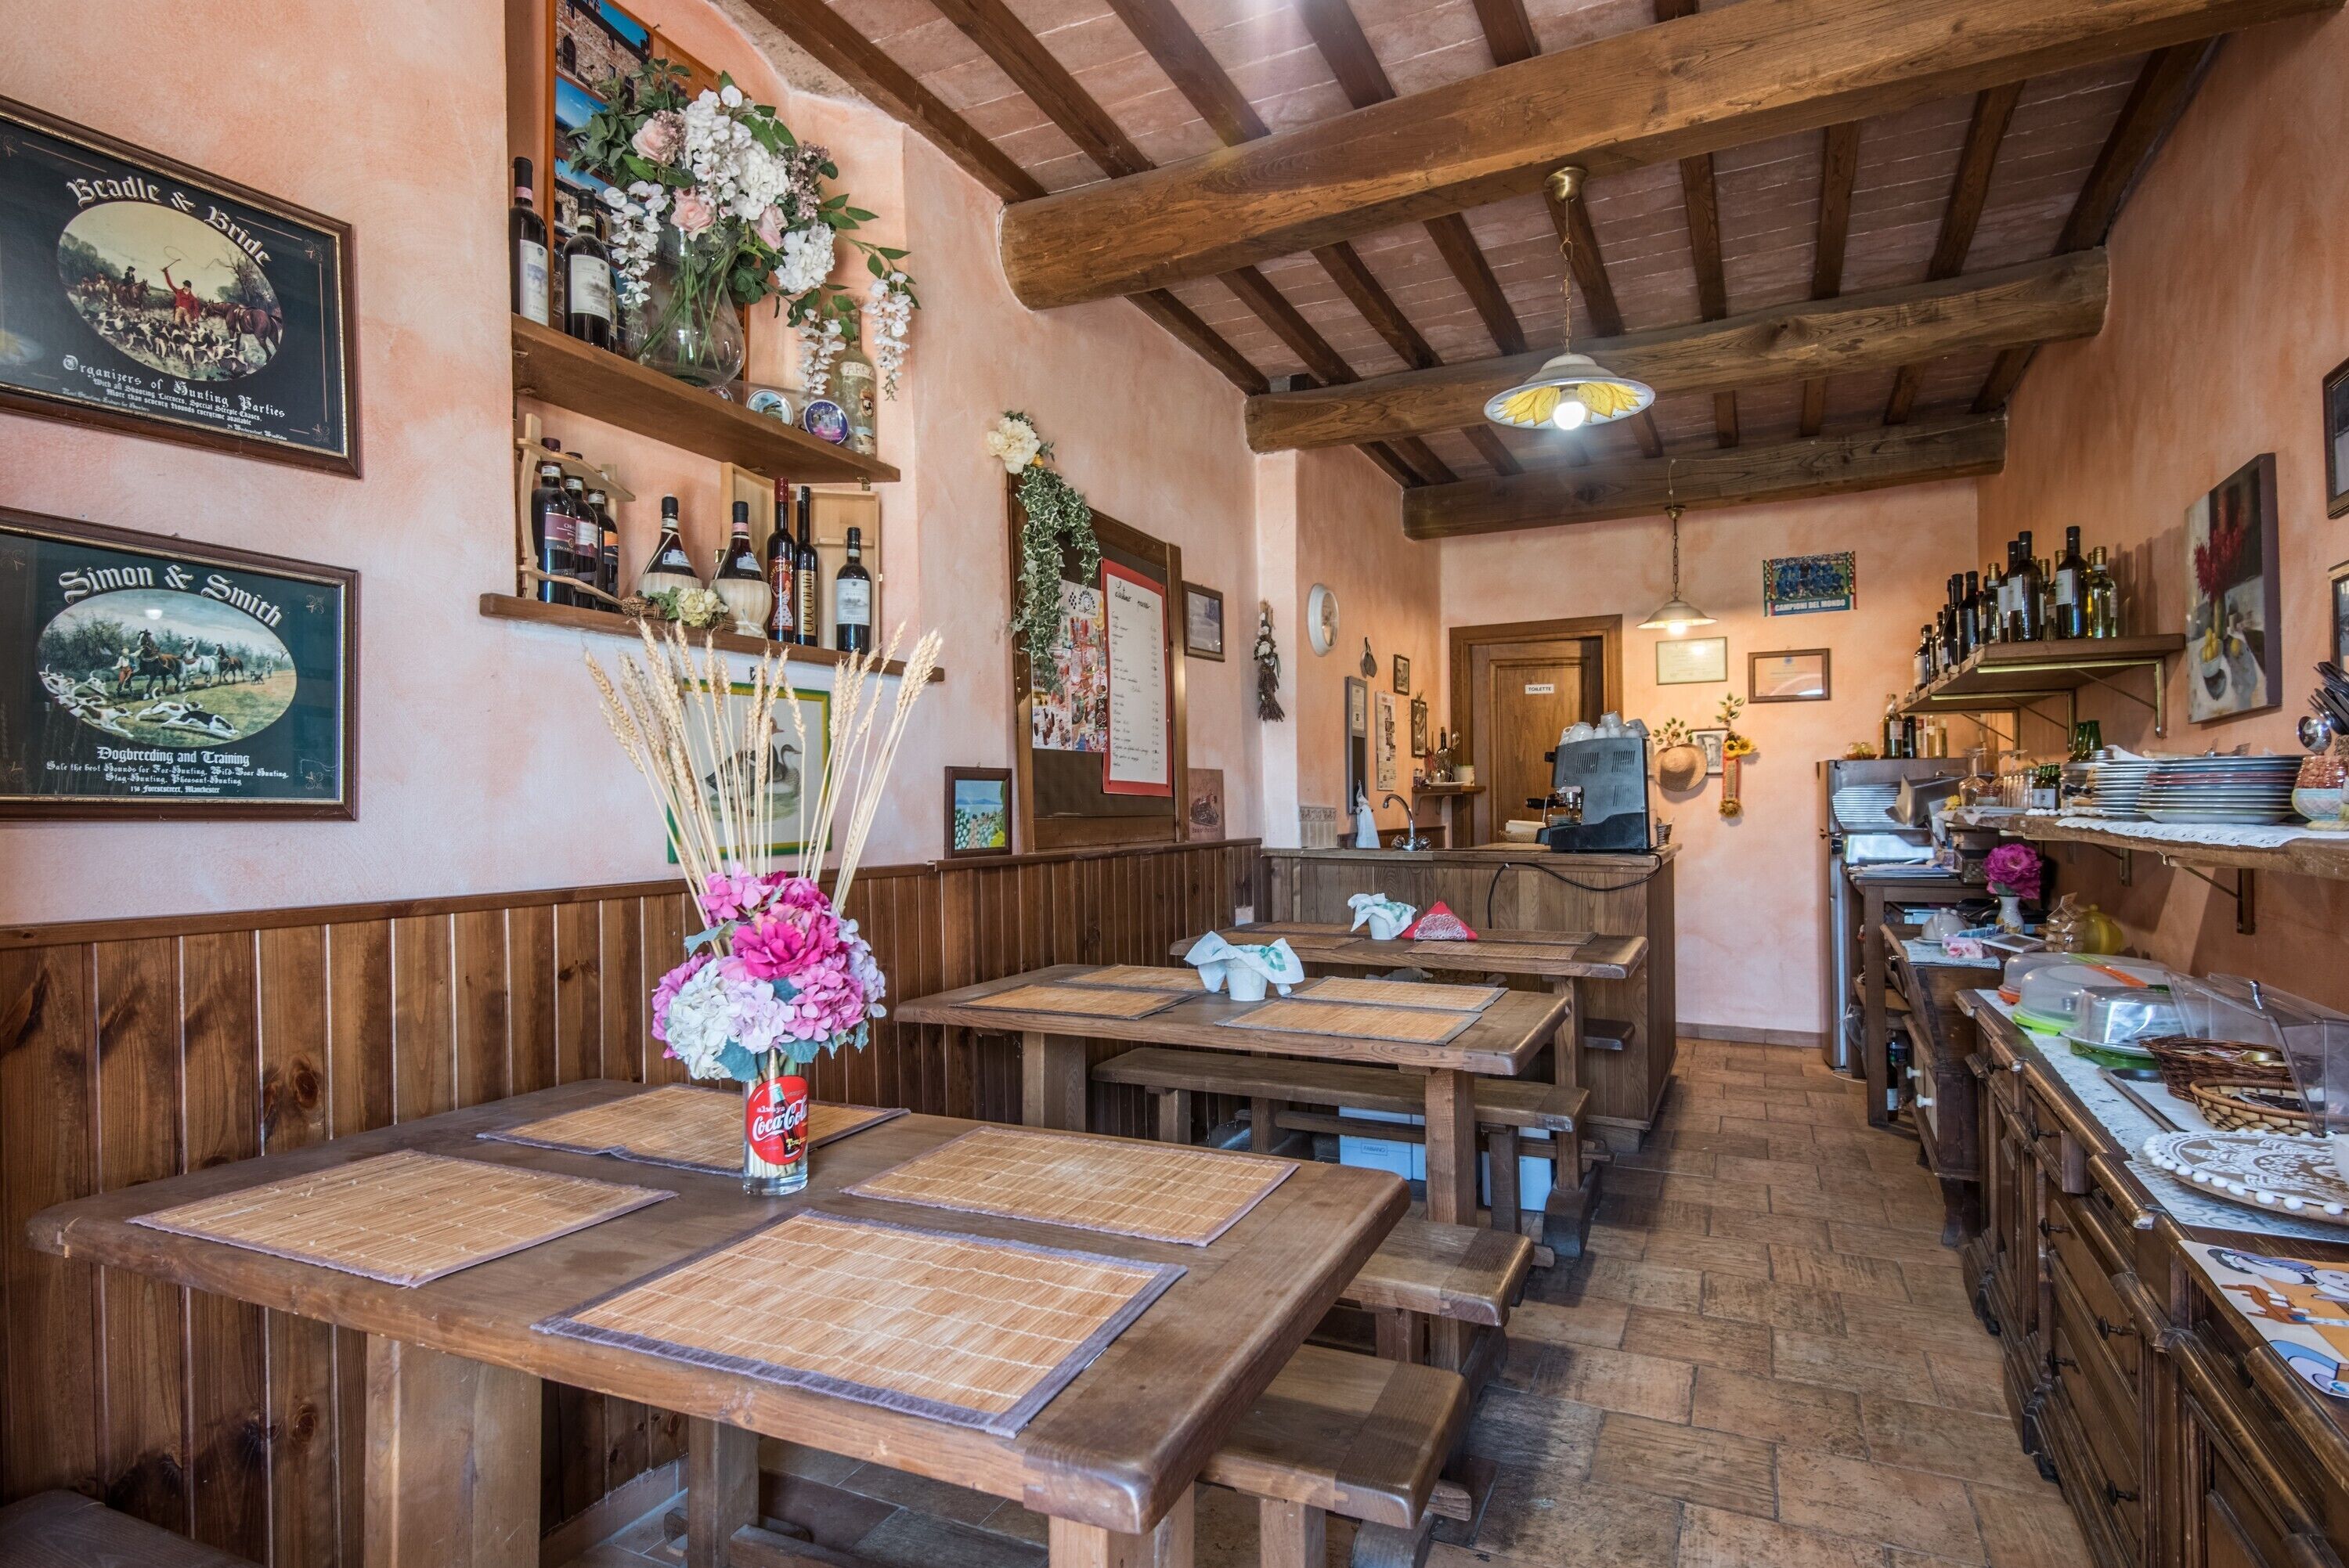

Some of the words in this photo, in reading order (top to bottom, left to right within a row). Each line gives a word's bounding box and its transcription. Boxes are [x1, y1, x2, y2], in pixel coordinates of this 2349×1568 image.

[66, 175, 162, 208] Beadle
[170, 191, 196, 213] &
[204, 206, 272, 268] Bride
[63, 355, 142, 385] Organizers
[150, 378, 164, 390] of
[173, 380, 229, 409] Hunting
[237, 395, 285, 418] Parties
[93, 377, 112, 388] With
[114, 382, 123, 391] all
[124, 385, 156, 399] Shooting
[189, 399, 213, 411] Special
[106, 388, 125, 399] More
[128, 394, 143, 402] than
[144, 398, 168, 409] seventy
[171, 402, 195, 414] Hounds
[226, 415, 252, 427] available
[59, 566, 155, 605] Simon
[164, 564, 194, 591] &
[200, 574, 283, 628] Smith
[1774, 602, 1807, 611] CAMPIONI
[1820, 599, 1846, 607] MONDO
[46, 761, 68, 771] Sale
[103, 762, 136, 773] Hounds
[96, 746, 173, 764] Dogbreeding
[177, 751, 197, 762] and
[200, 751, 250, 766] Training
